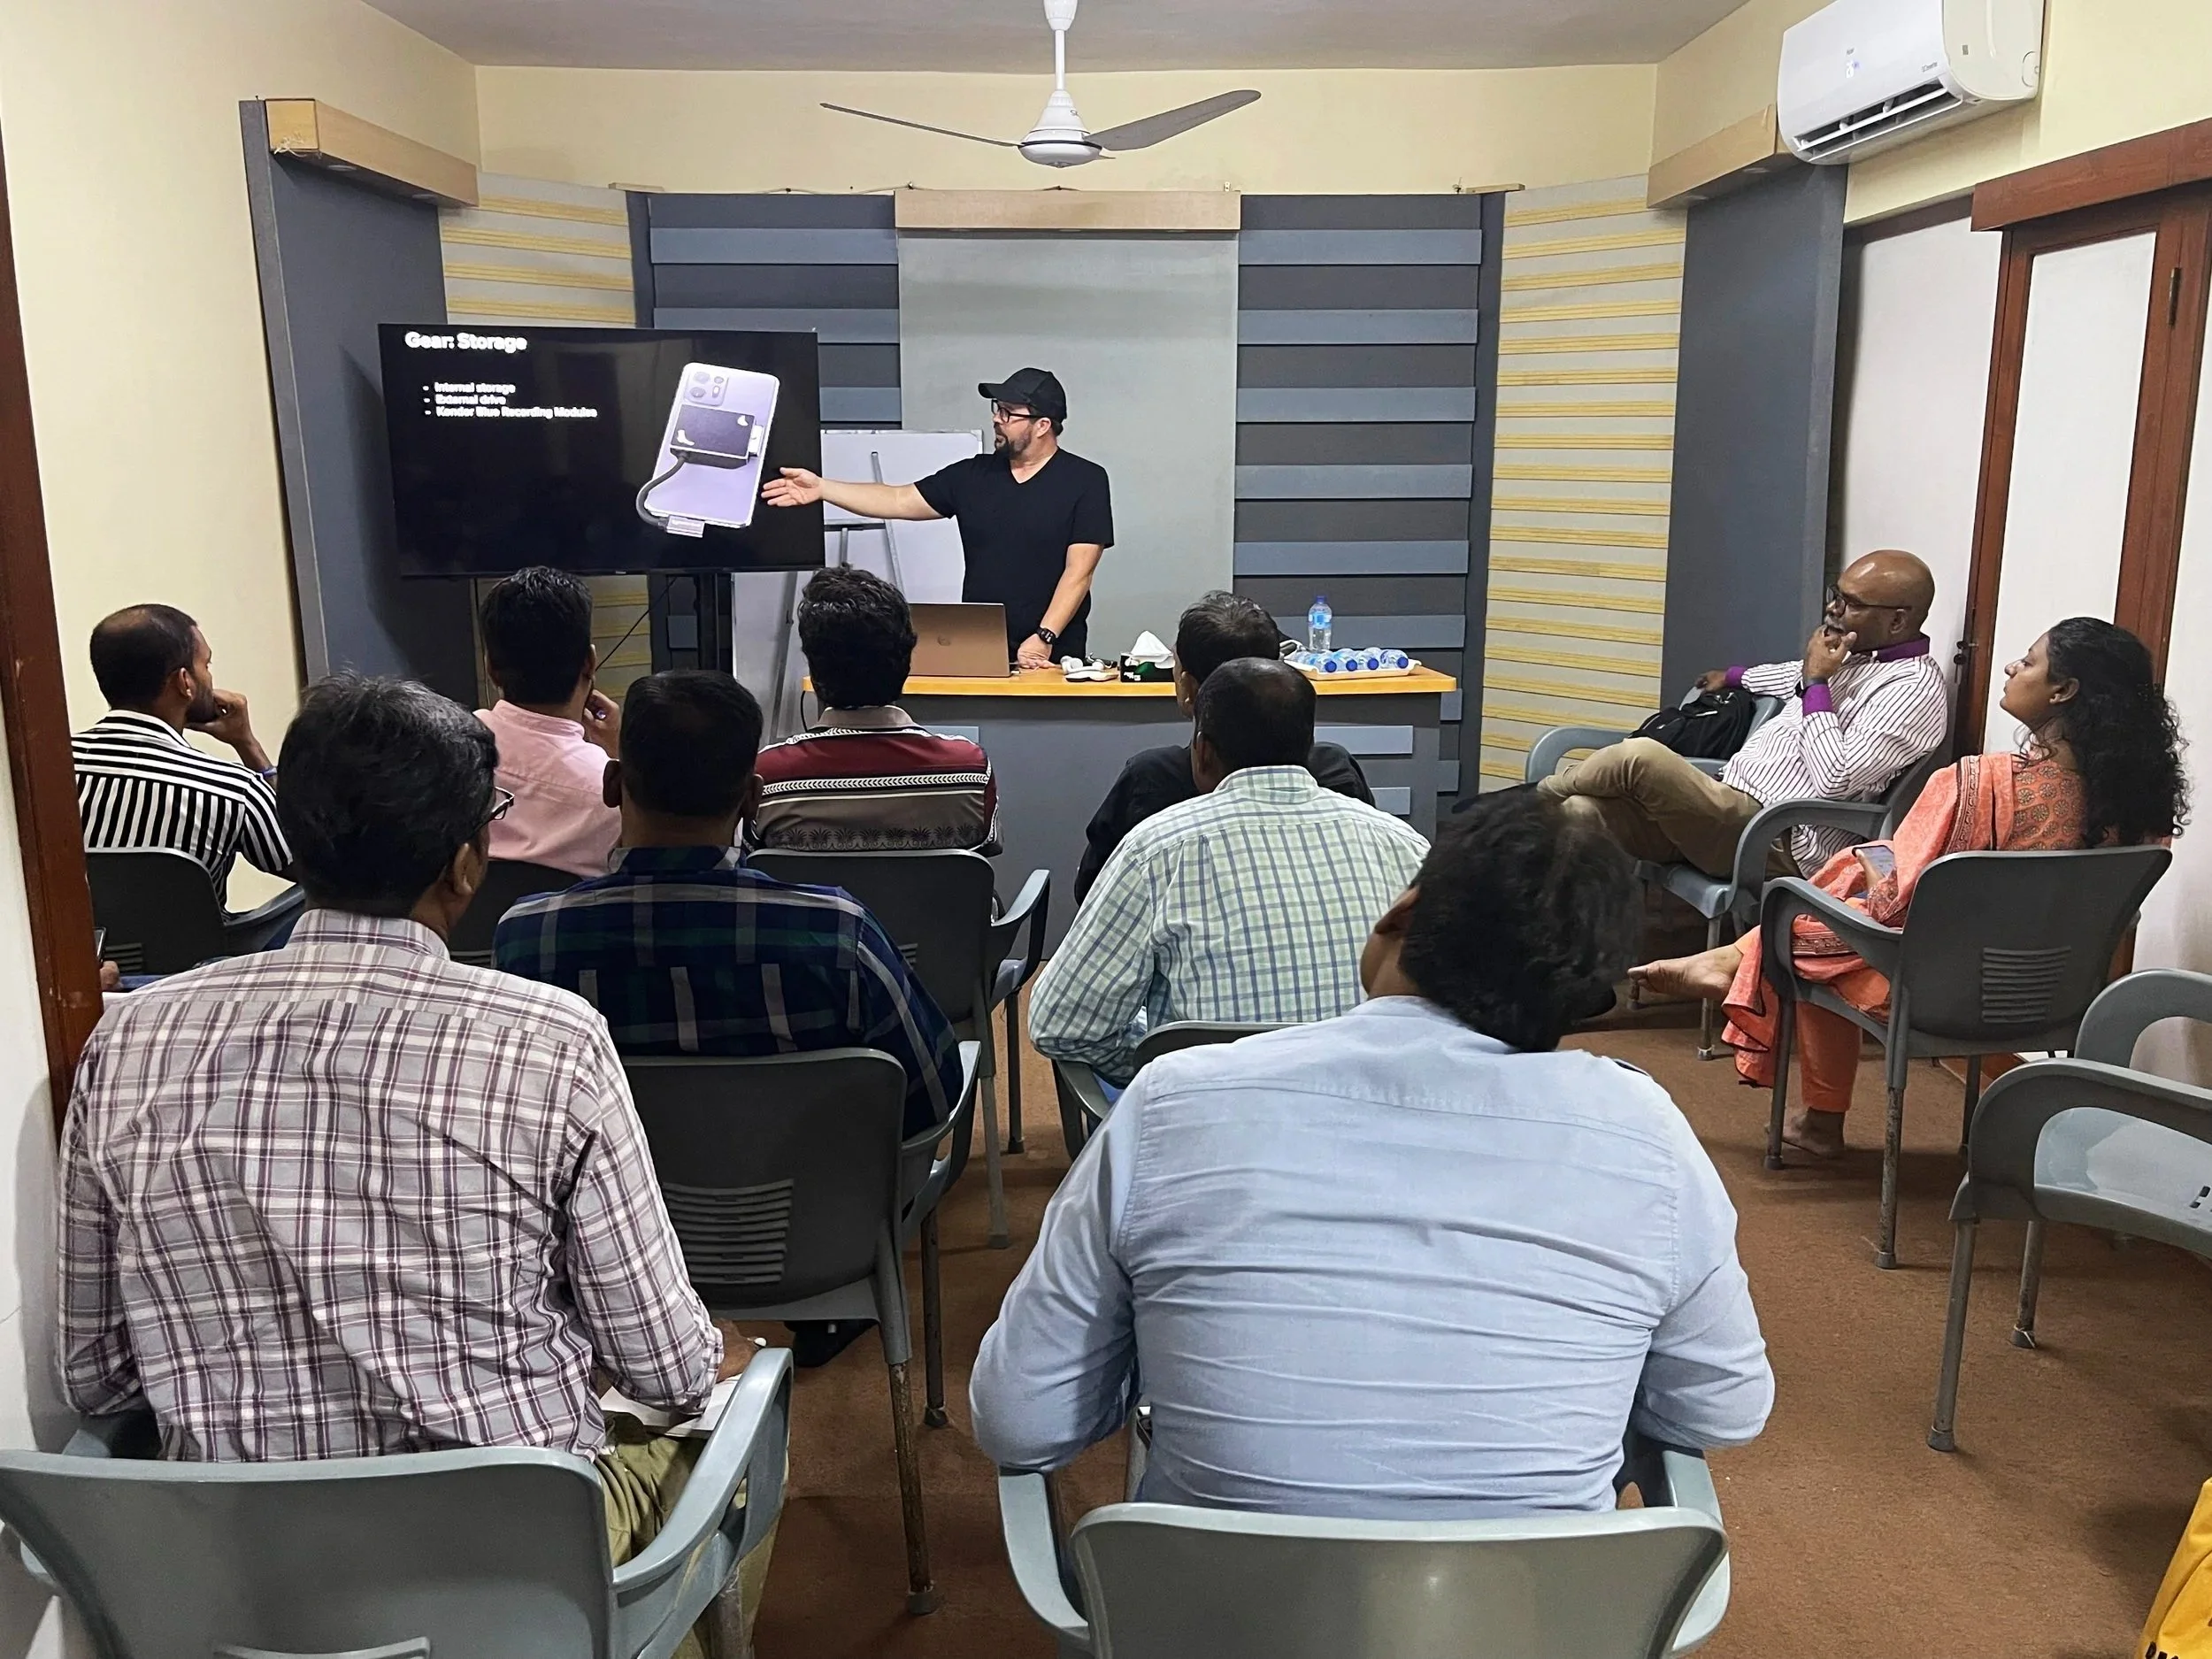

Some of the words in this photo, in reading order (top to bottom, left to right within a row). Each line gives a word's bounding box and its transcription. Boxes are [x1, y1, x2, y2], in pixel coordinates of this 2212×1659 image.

[457, 333, 528, 354] Storage
[434, 382, 475, 393] Internal
[476, 383, 516, 396] storage
[435, 394, 479, 405] External
[479, 395, 507, 405] drive
[501, 406, 553, 419] Recording
[553, 406, 597, 418] Modules
